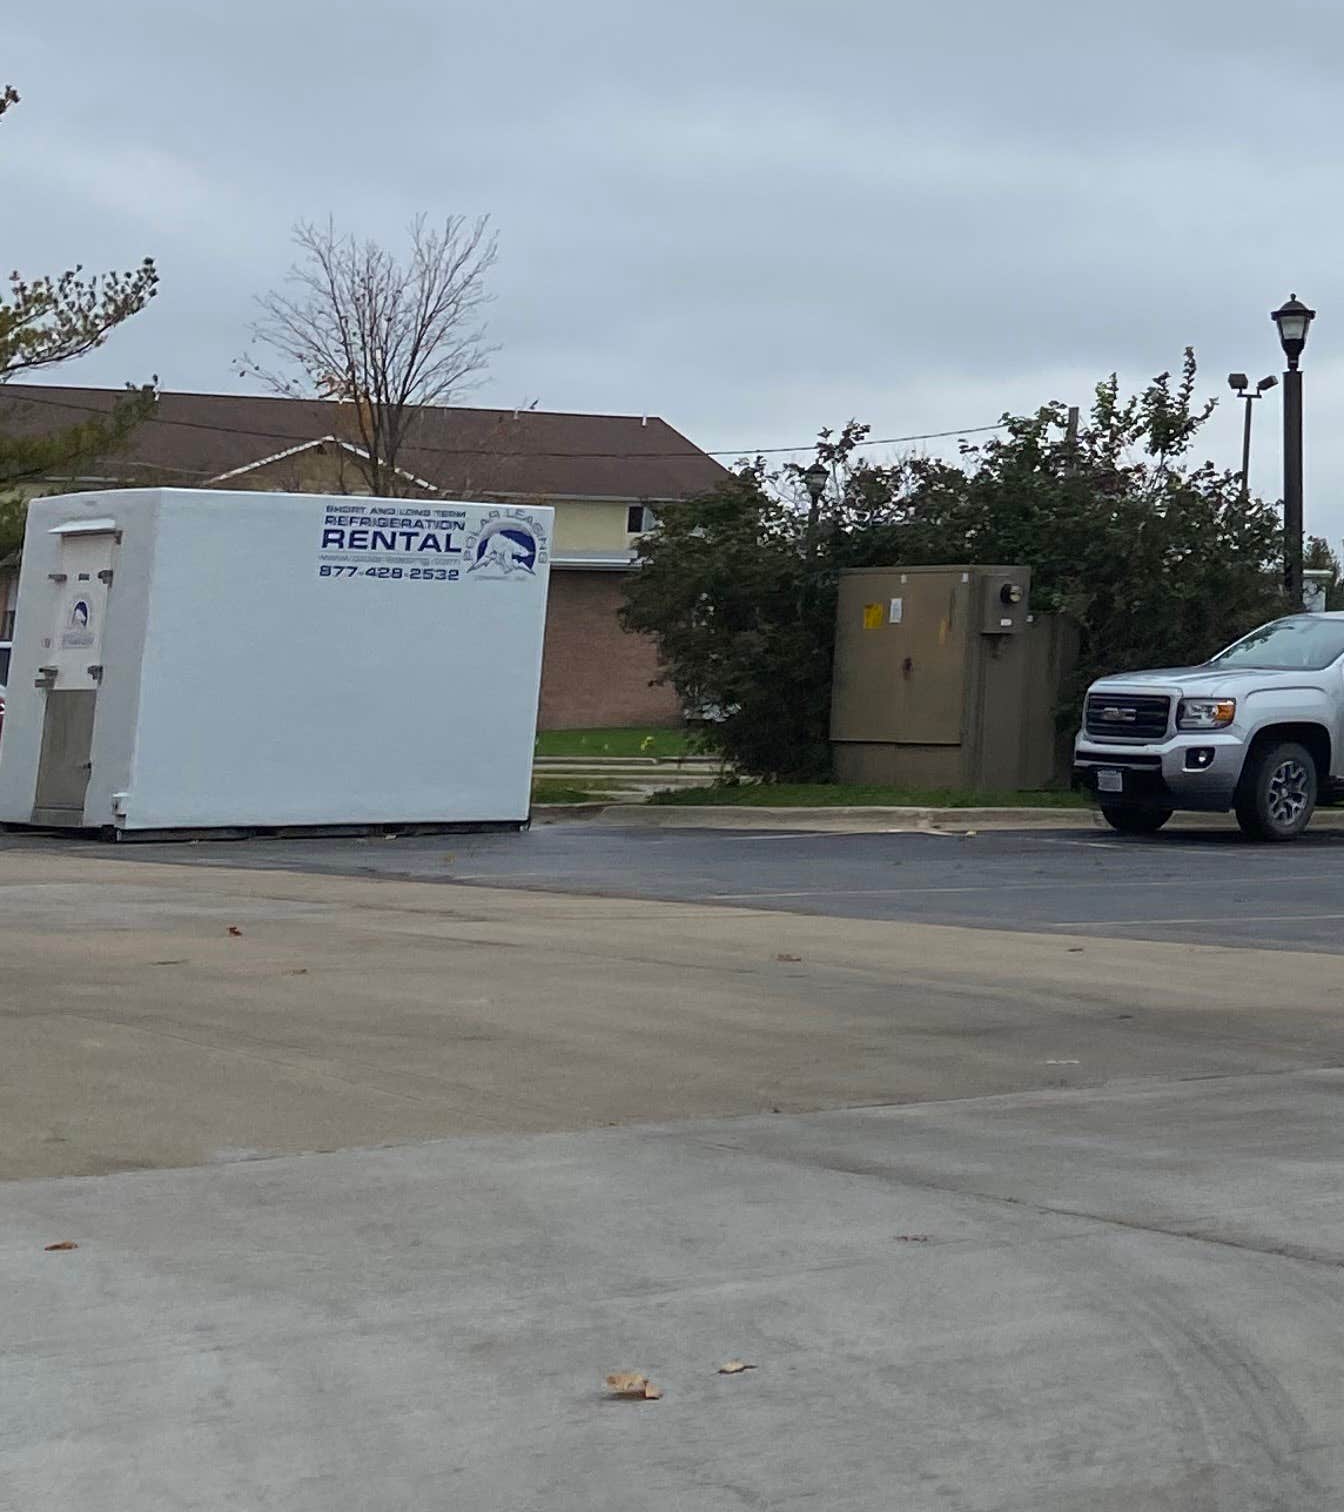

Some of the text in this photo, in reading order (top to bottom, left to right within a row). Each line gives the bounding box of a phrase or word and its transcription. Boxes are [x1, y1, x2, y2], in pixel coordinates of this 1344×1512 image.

[370, 507, 397, 516] AND
[324, 515, 467, 532] REFRIGERATION
[321, 528, 463, 554] RENTAL
[319, 564, 460, 582] 877-428-2532
